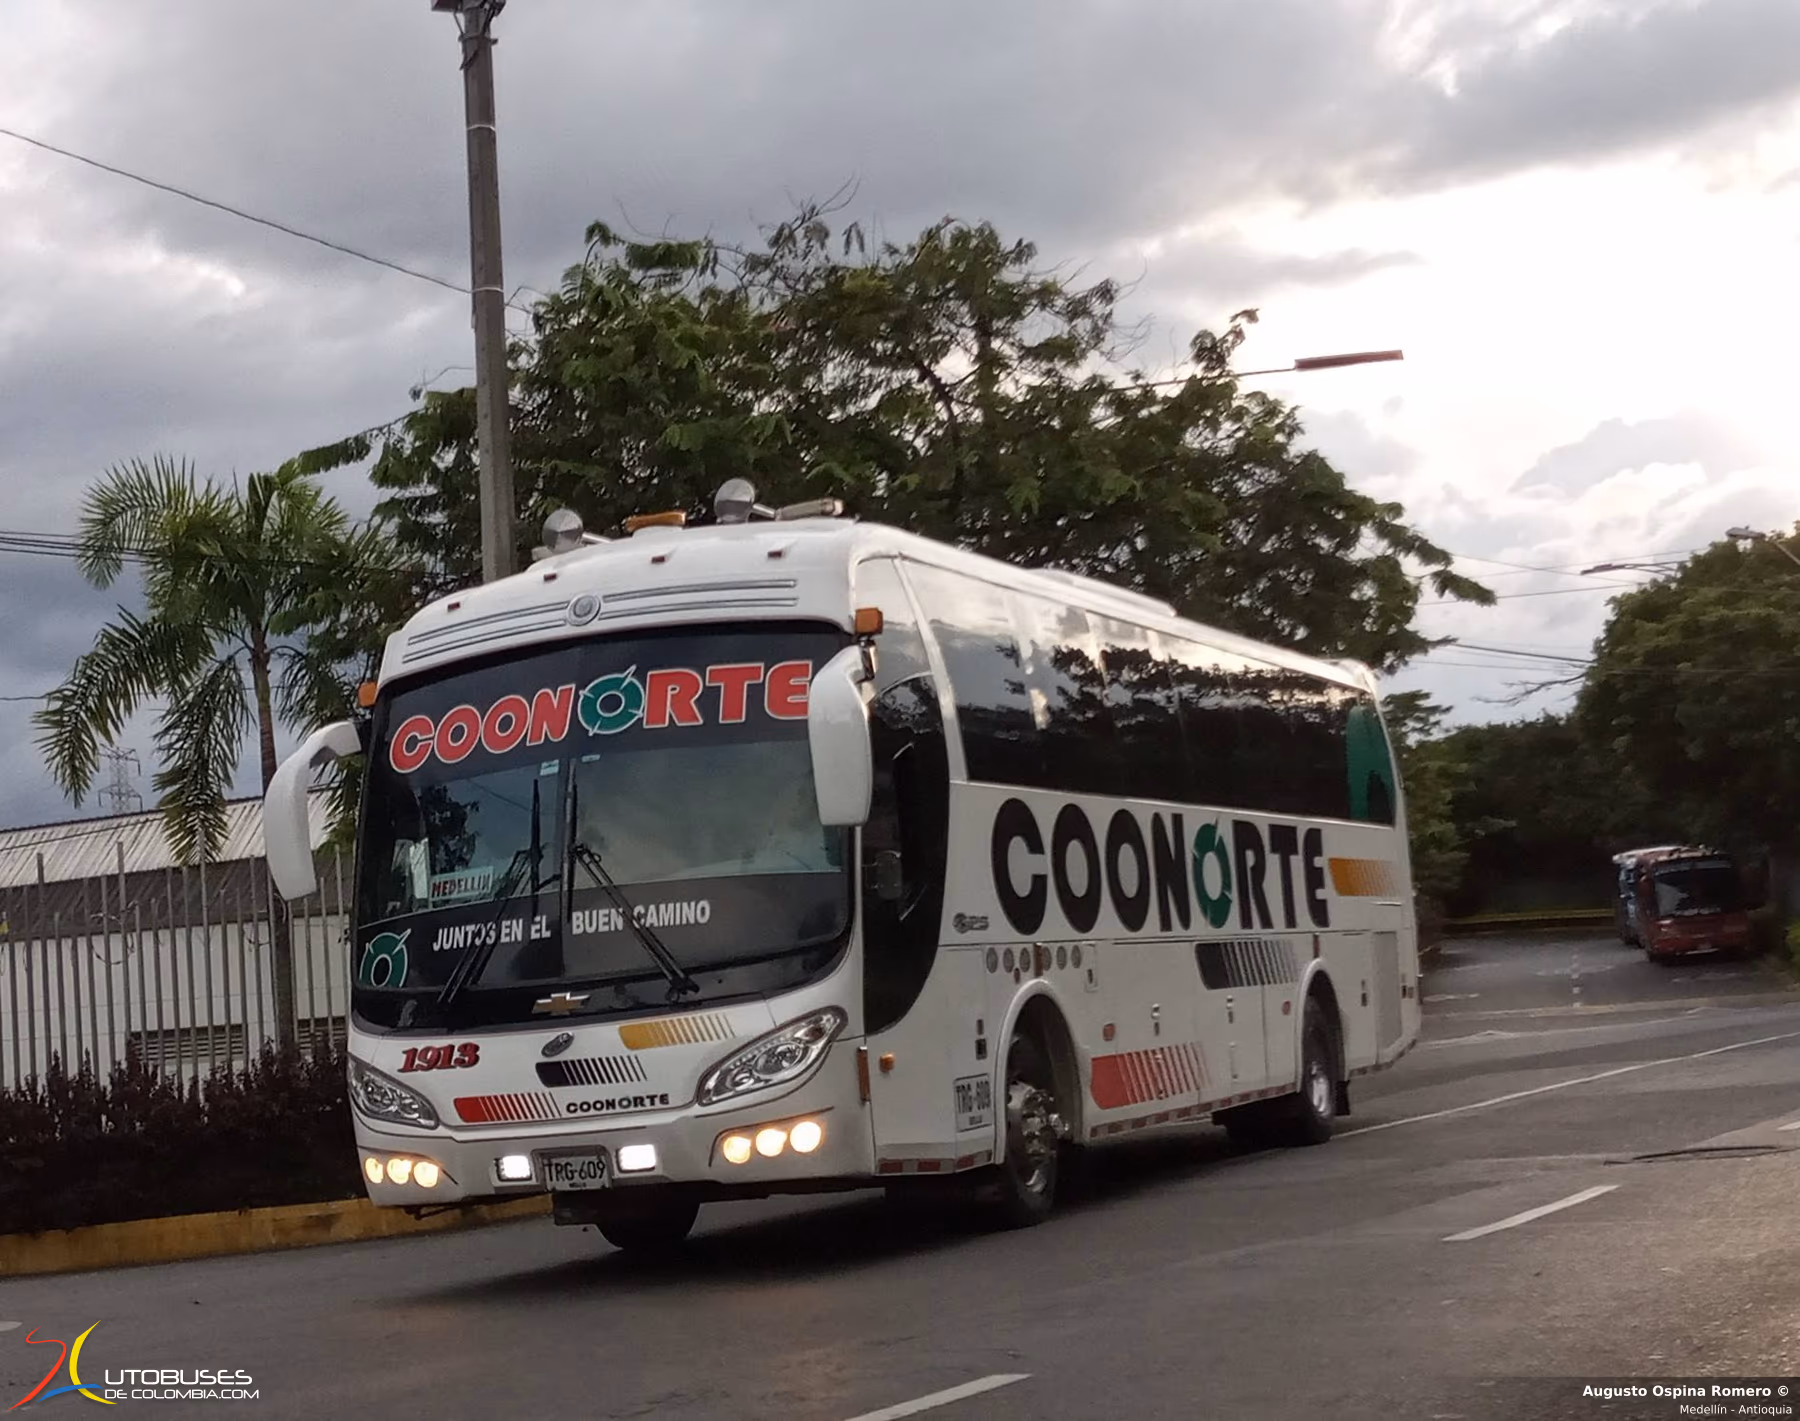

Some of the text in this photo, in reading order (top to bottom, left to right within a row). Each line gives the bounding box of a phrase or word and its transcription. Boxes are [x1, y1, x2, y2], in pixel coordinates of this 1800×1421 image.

[389, 659, 813, 774] COONORTE
[991, 797, 1331, 936] COONORTE
[432, 899, 711, 952] JUNTOS EN EL BUEN CAMINO
[397, 1042, 481, 1073] 1913
[565, 1093, 670, 1114] COONORTE
[544, 1160, 606, 1182] TRG-609
